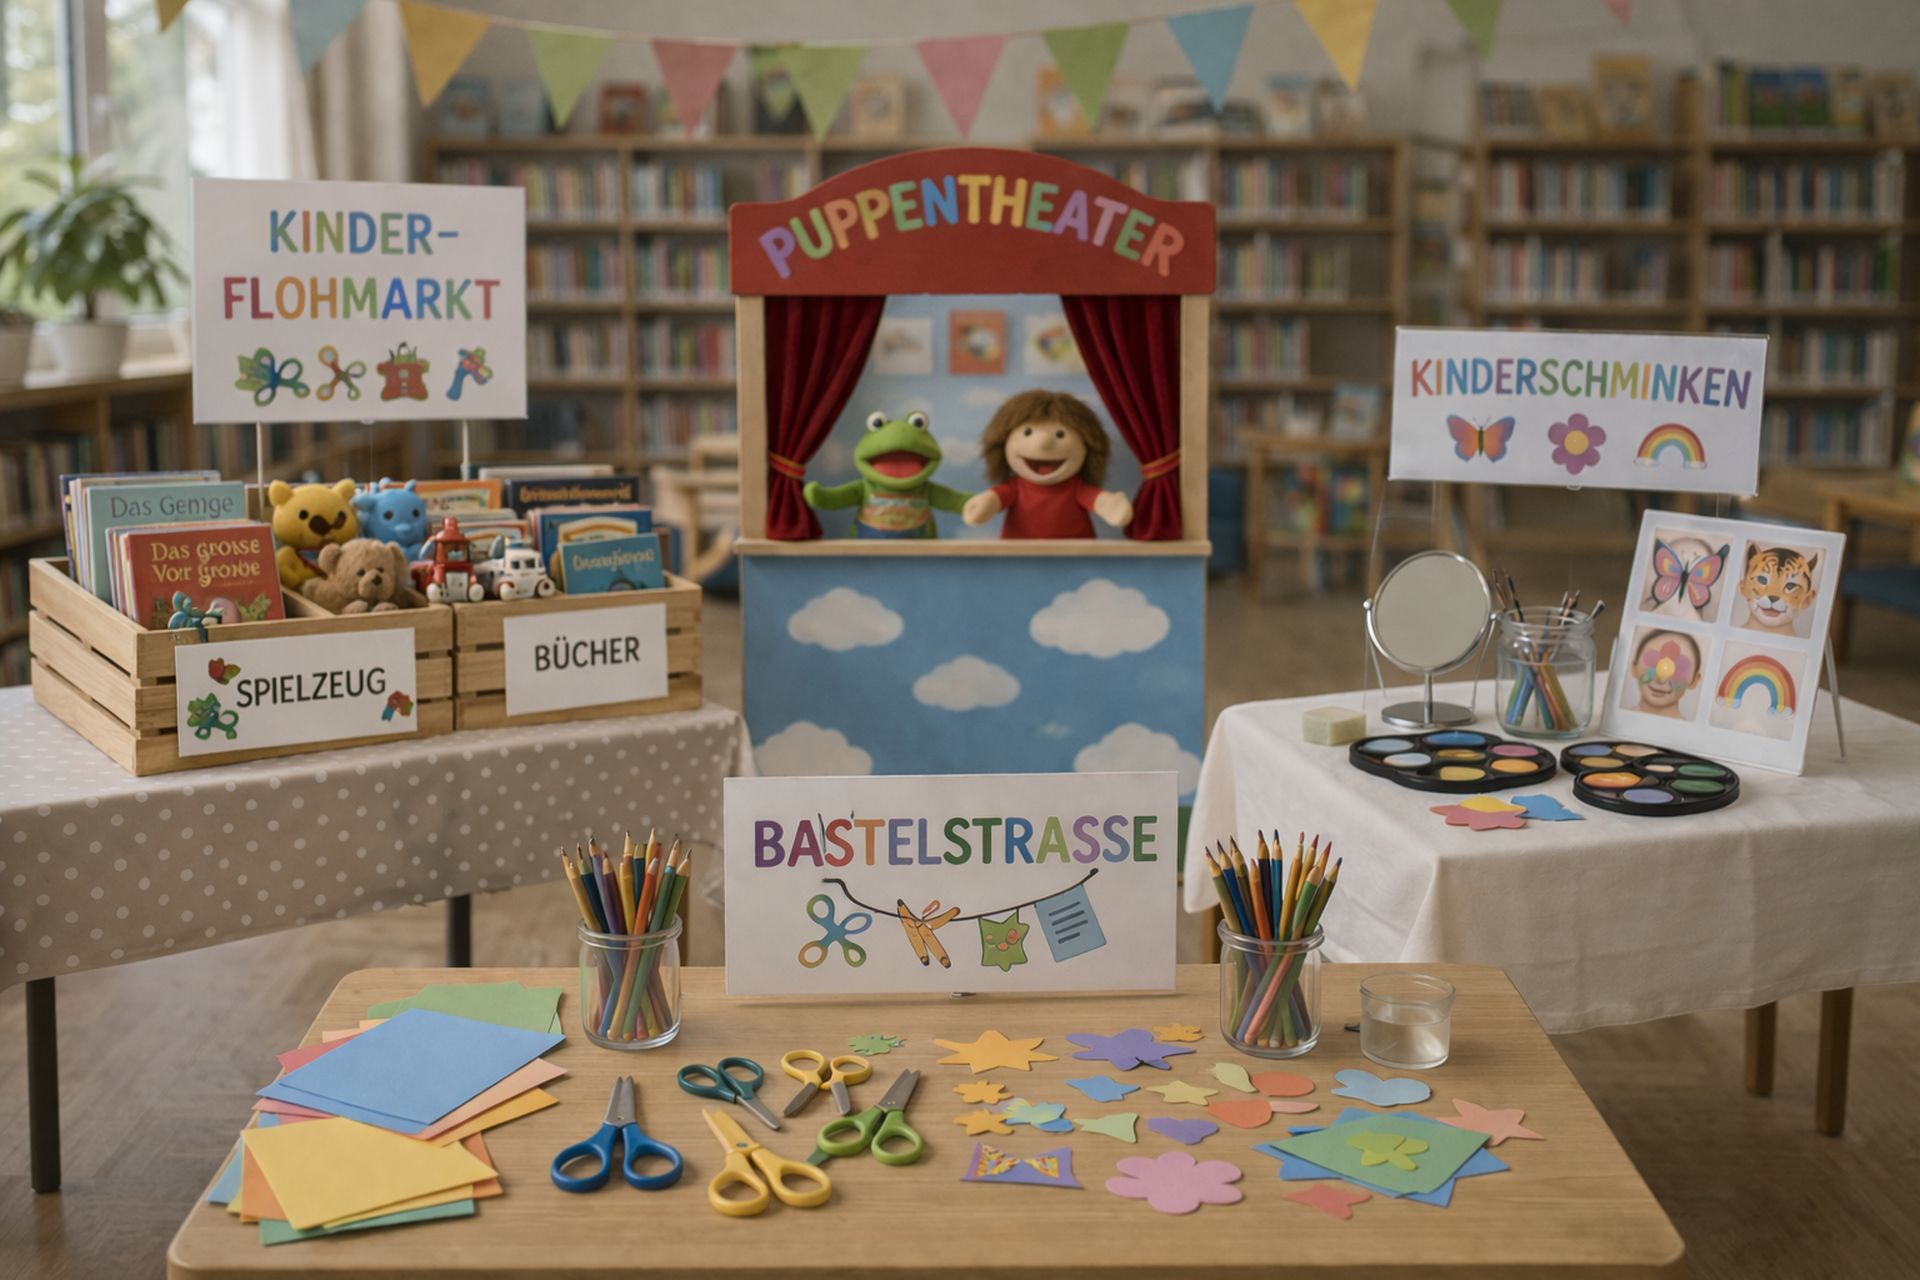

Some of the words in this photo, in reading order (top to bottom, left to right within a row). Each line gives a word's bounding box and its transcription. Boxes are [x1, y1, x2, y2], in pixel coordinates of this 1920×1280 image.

[269, 209, 459, 255] KINDER-
[759, 174, 1185, 279] PUPPENTHEATER
[223, 276, 501, 320] FLOHMARKT
[1410, 358, 1752, 410] KINDERSCHMINKEN
[110, 496, 152, 519] Das
[151, 542, 190, 562] Das
[534, 635, 641, 672] BÜCHER
[236, 667, 386, 708] SPIELZEUG
[754, 815, 1158, 868] BASTELSTRASSE
